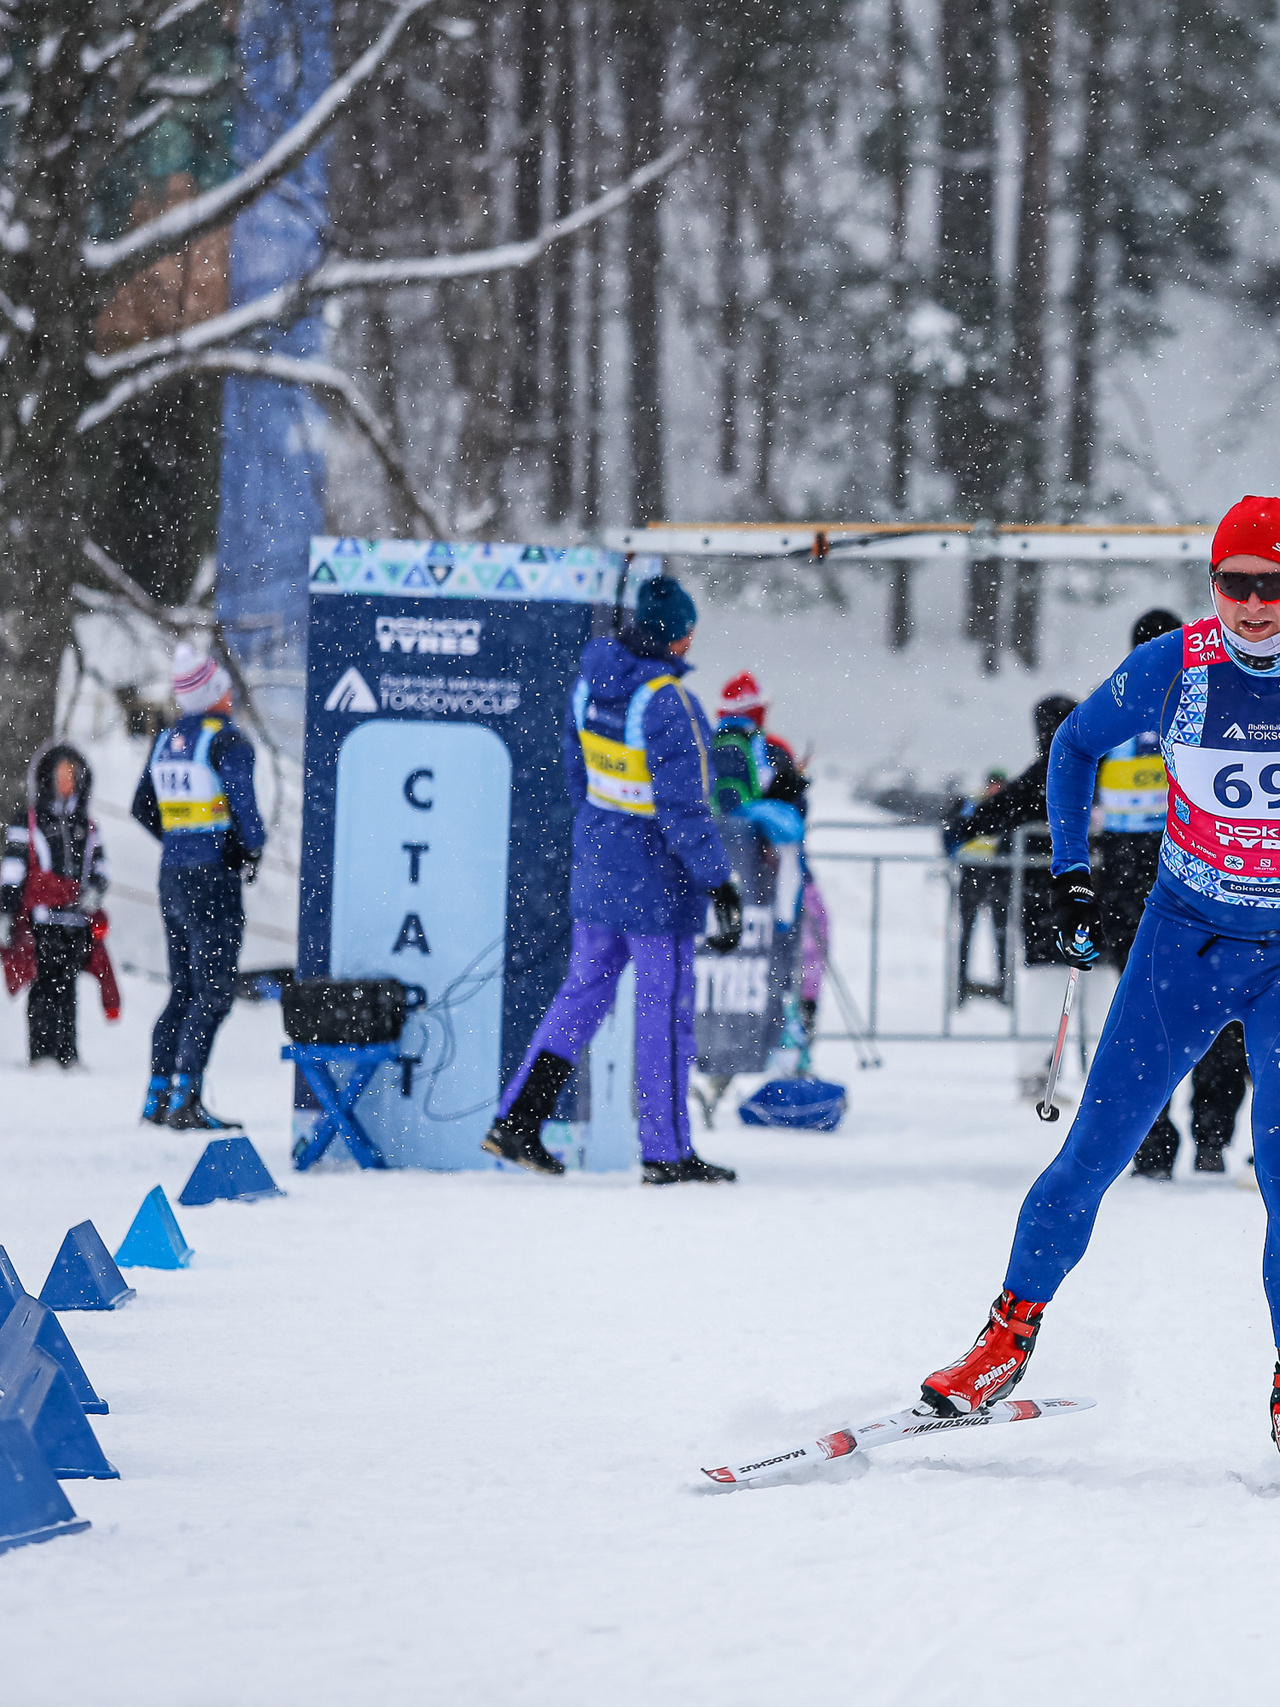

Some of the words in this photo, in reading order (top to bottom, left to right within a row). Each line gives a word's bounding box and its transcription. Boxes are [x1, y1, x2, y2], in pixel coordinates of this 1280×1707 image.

[1187, 628, 1221, 653] 34
[1195, 844, 1217, 859] ATOMIC
[973, 1357, 1018, 1391] alpina
[913, 1416, 993, 1434] MADSHUS
[737, 1449, 807, 1474] MADSHUS
